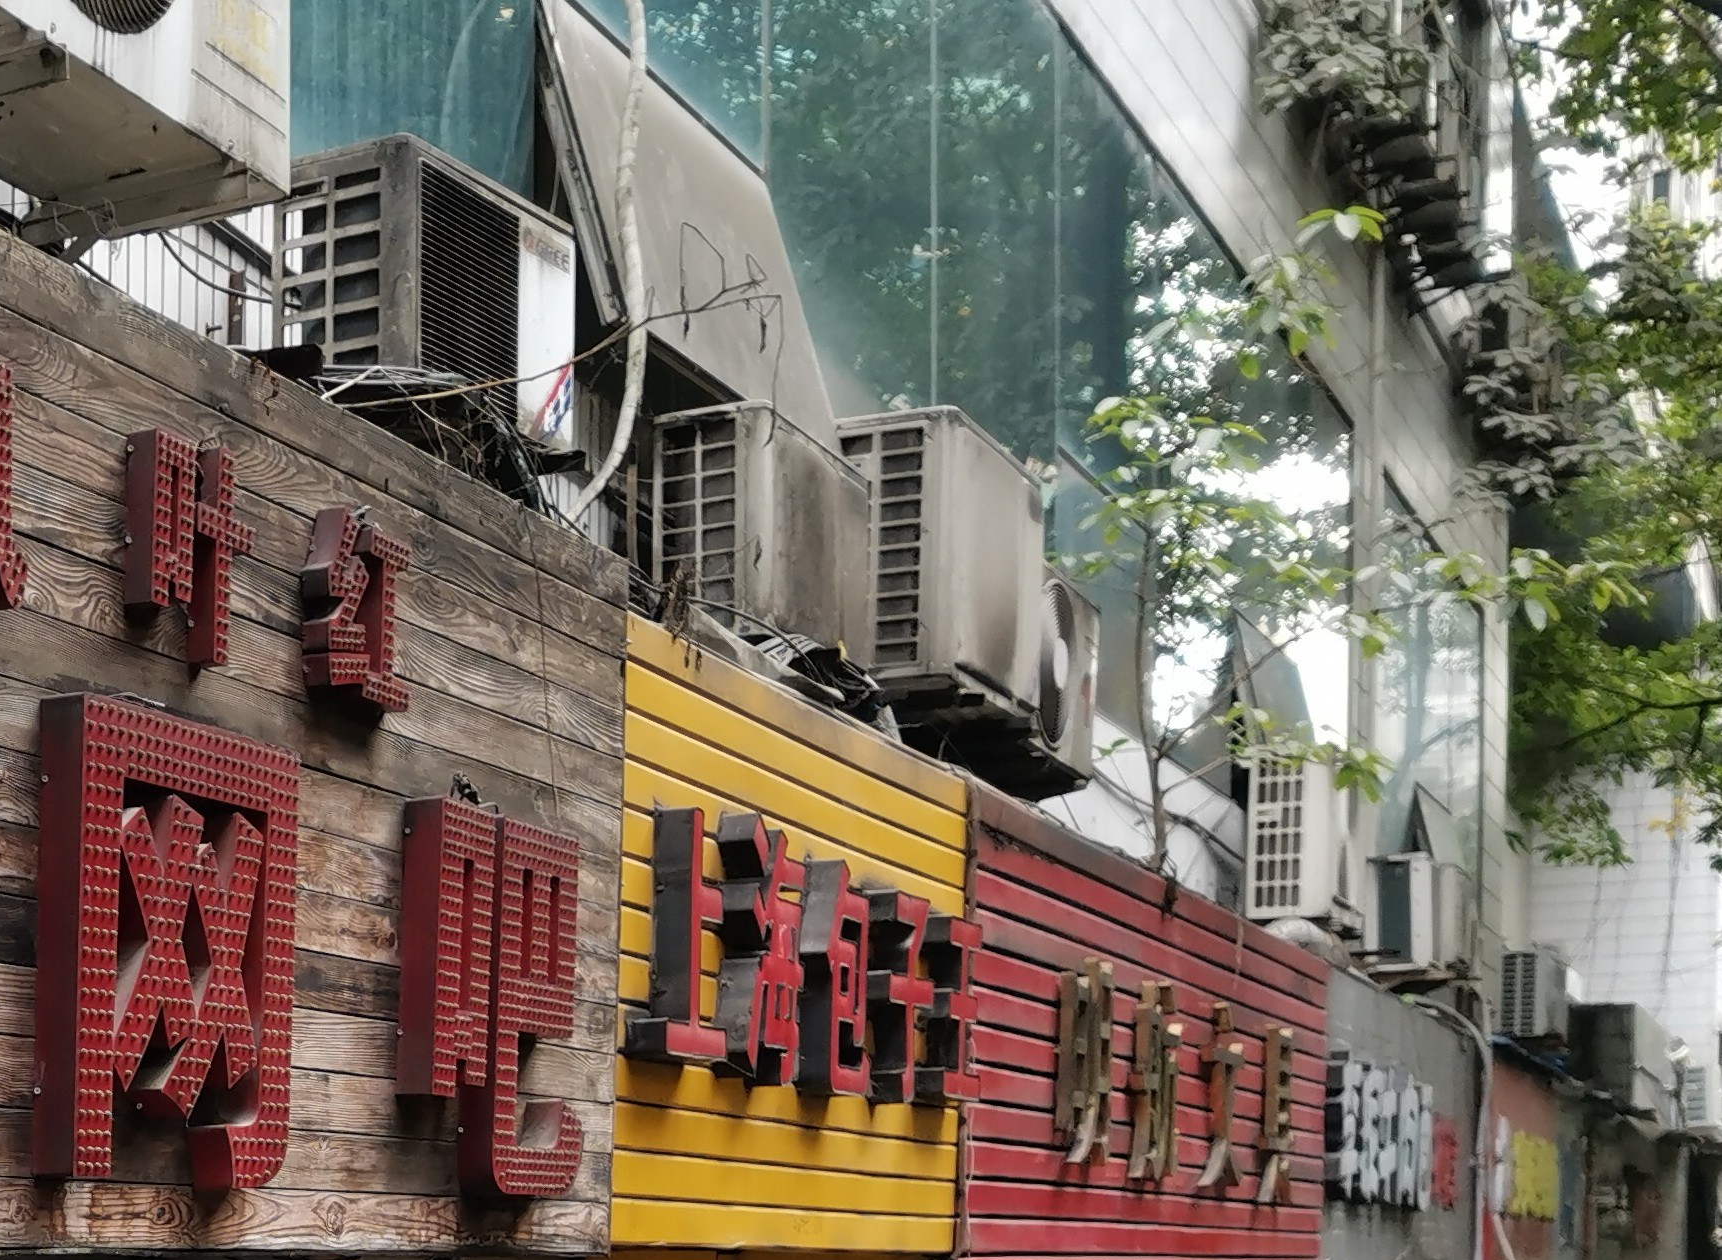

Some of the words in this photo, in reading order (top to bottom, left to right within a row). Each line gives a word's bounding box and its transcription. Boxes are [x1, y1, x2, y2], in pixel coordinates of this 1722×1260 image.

[34, 692, 585, 1197] 网吧
[630, 806, 983, 1103] 上海包子王
